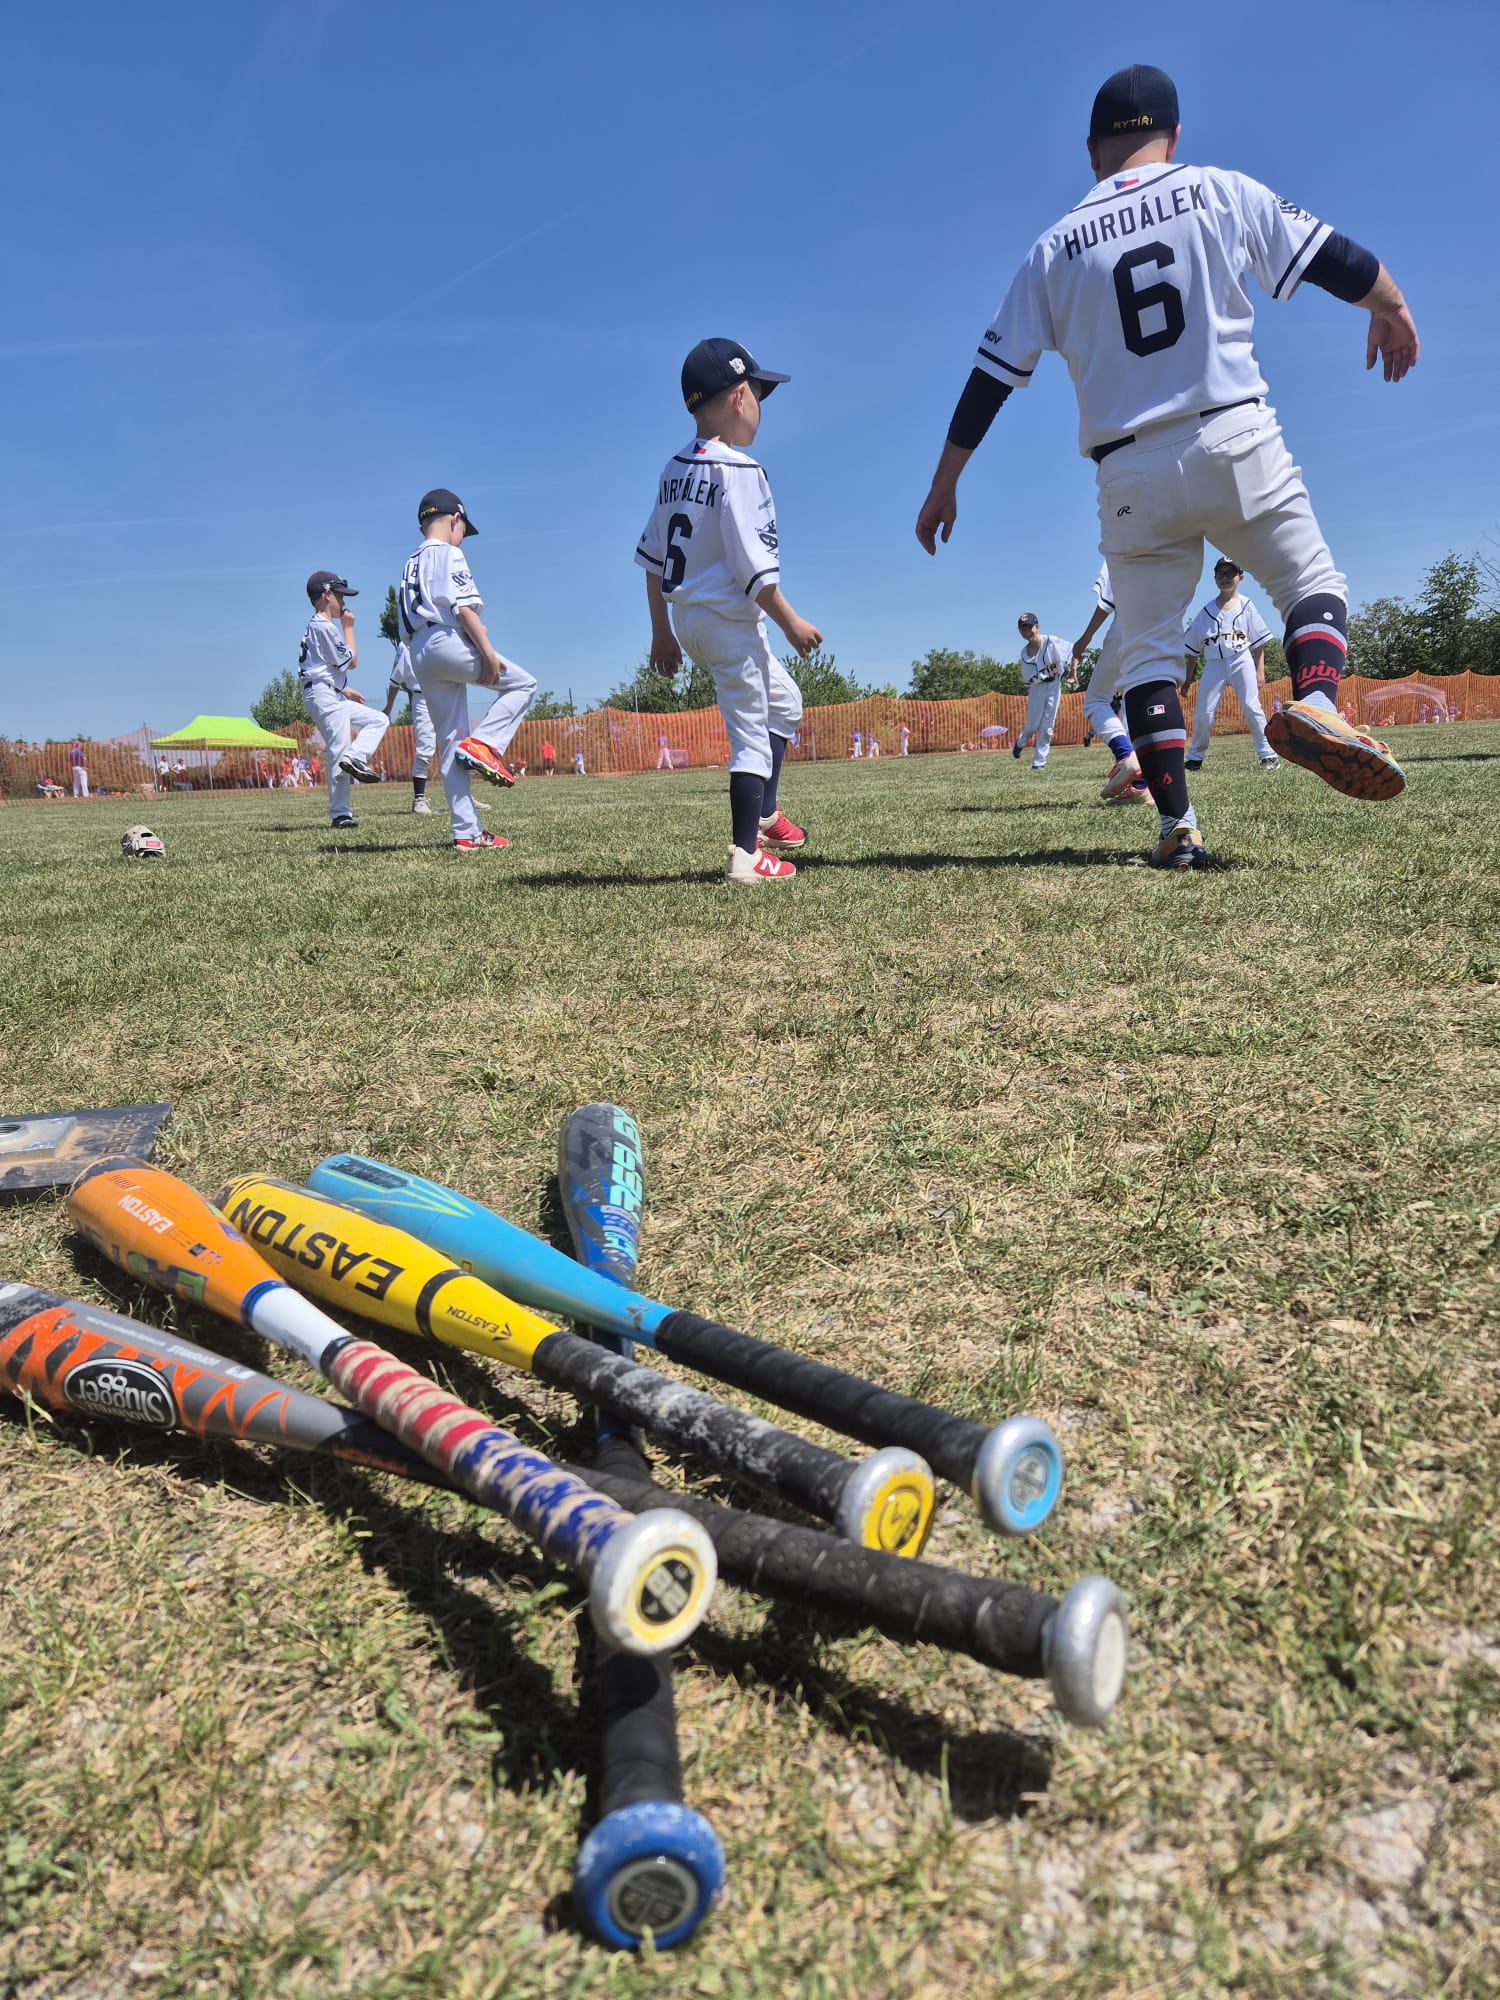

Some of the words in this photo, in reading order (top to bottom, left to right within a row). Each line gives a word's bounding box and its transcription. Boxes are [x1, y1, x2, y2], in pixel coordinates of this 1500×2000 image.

[1064, 183, 1207, 261] HURDÁLEK
[1112, 240, 1186, 358] 6
[661, 513, 693, 594] 6
[119, 1194, 175, 1234] EASTON
[229, 1197, 406, 1302] EASTON
[446, 1305, 500, 1334] EASTON
[76, 1372, 166, 1423] Slugger
